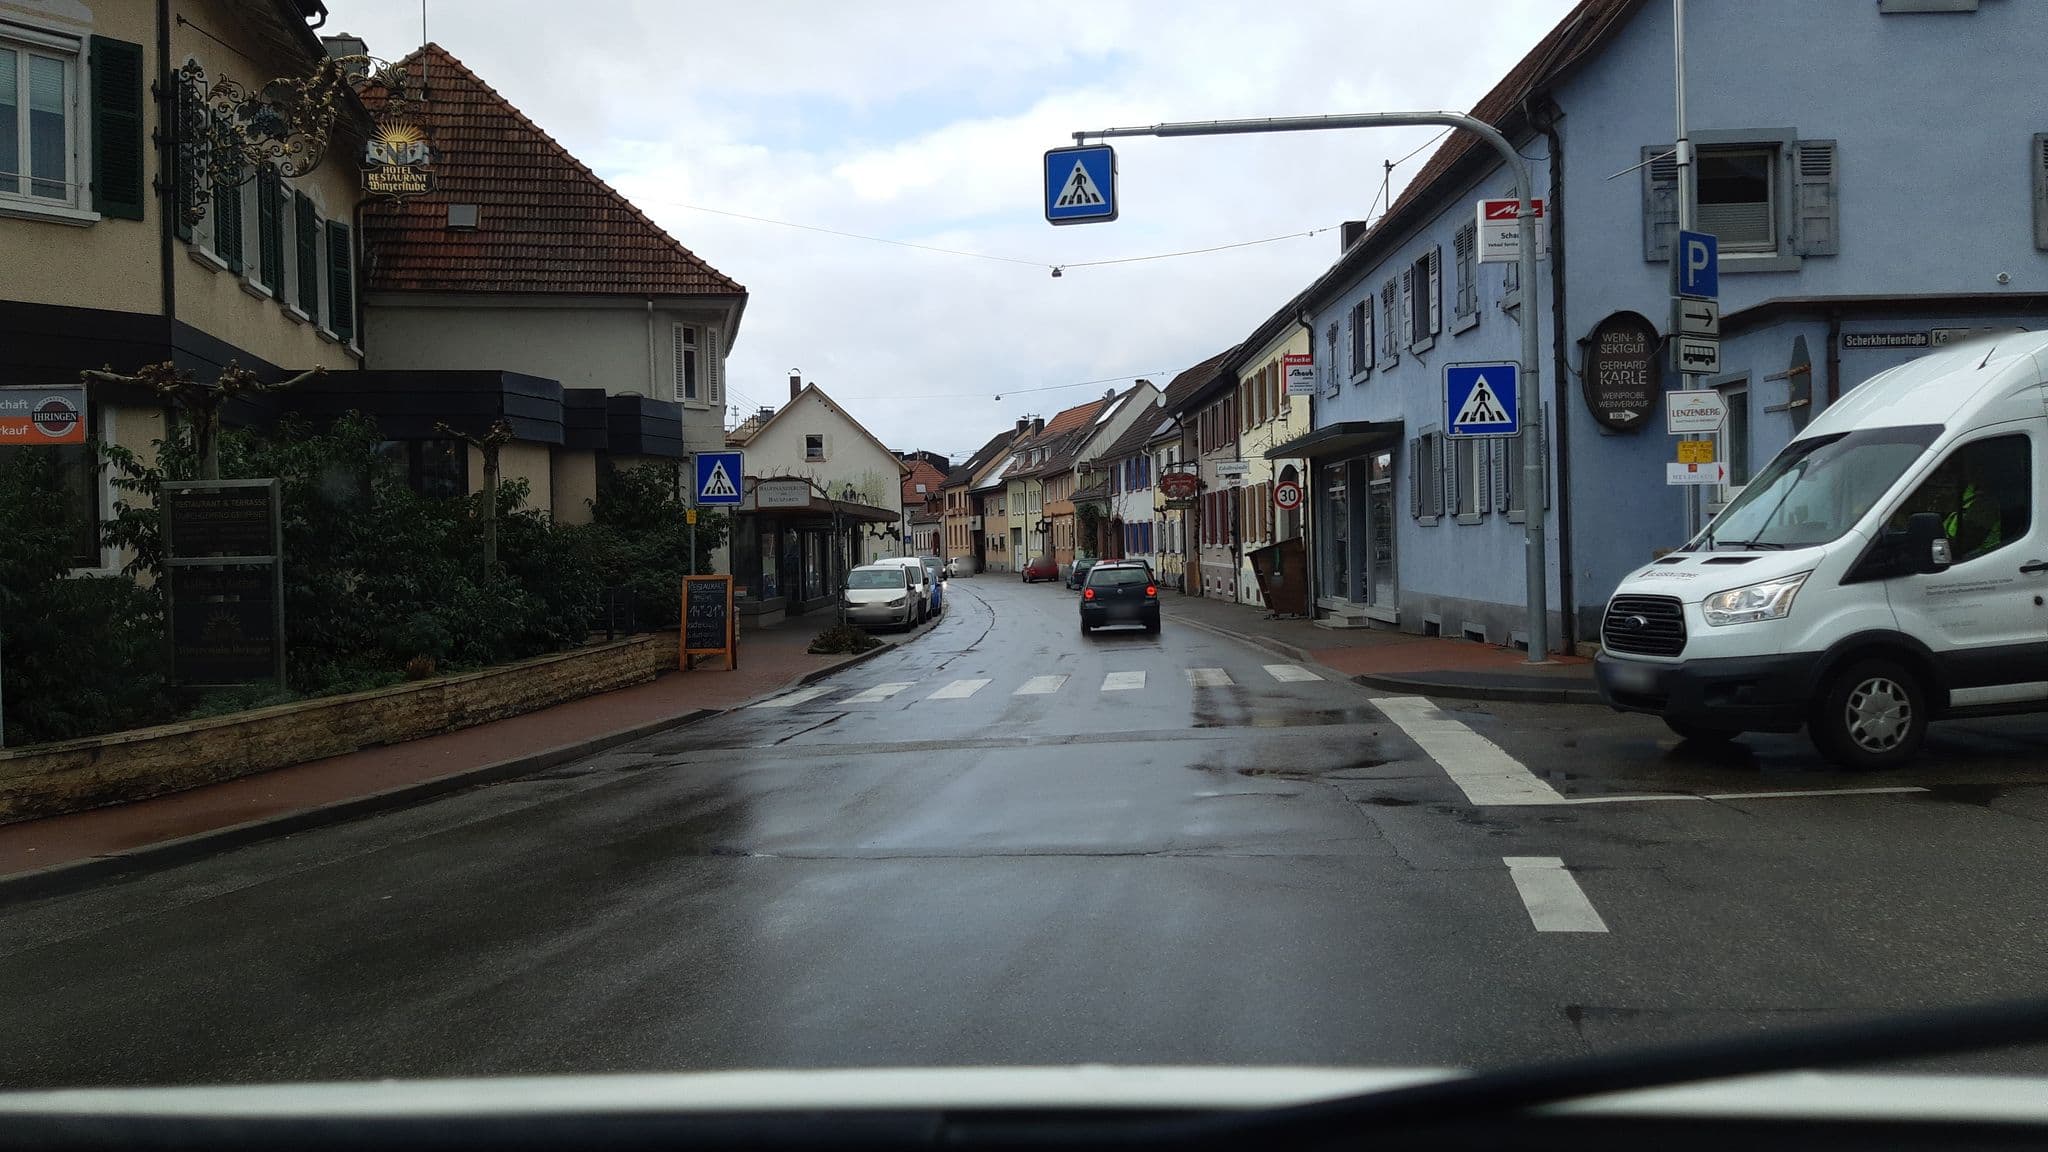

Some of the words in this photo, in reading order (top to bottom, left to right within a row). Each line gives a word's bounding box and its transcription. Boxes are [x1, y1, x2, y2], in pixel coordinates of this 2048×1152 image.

[383, 166, 411, 174] HOTEL
[368, 173, 427, 182] RESTAURANT
[1688, 240, 1709, 287] P
[1602, 332, 1633, 342] WEIN-
[1637, 332, 1646, 342] &
[1846, 334, 1926, 347] Scherkhofenstraße
[1600, 343, 1645, 354] SEKTGUT
[1600, 360, 1647, 370] GERHARD
[1600, 370, 1647, 385] KARLE
[1602, 391, 1645, 400] WEINPROBE
[1598, 399, 1649, 408] WEINVERKAUF
[33, 412, 77, 421] IHRINGEN
[1671, 408, 1721, 418] LENZENBERG
[1279, 488, 1296, 502] 30
